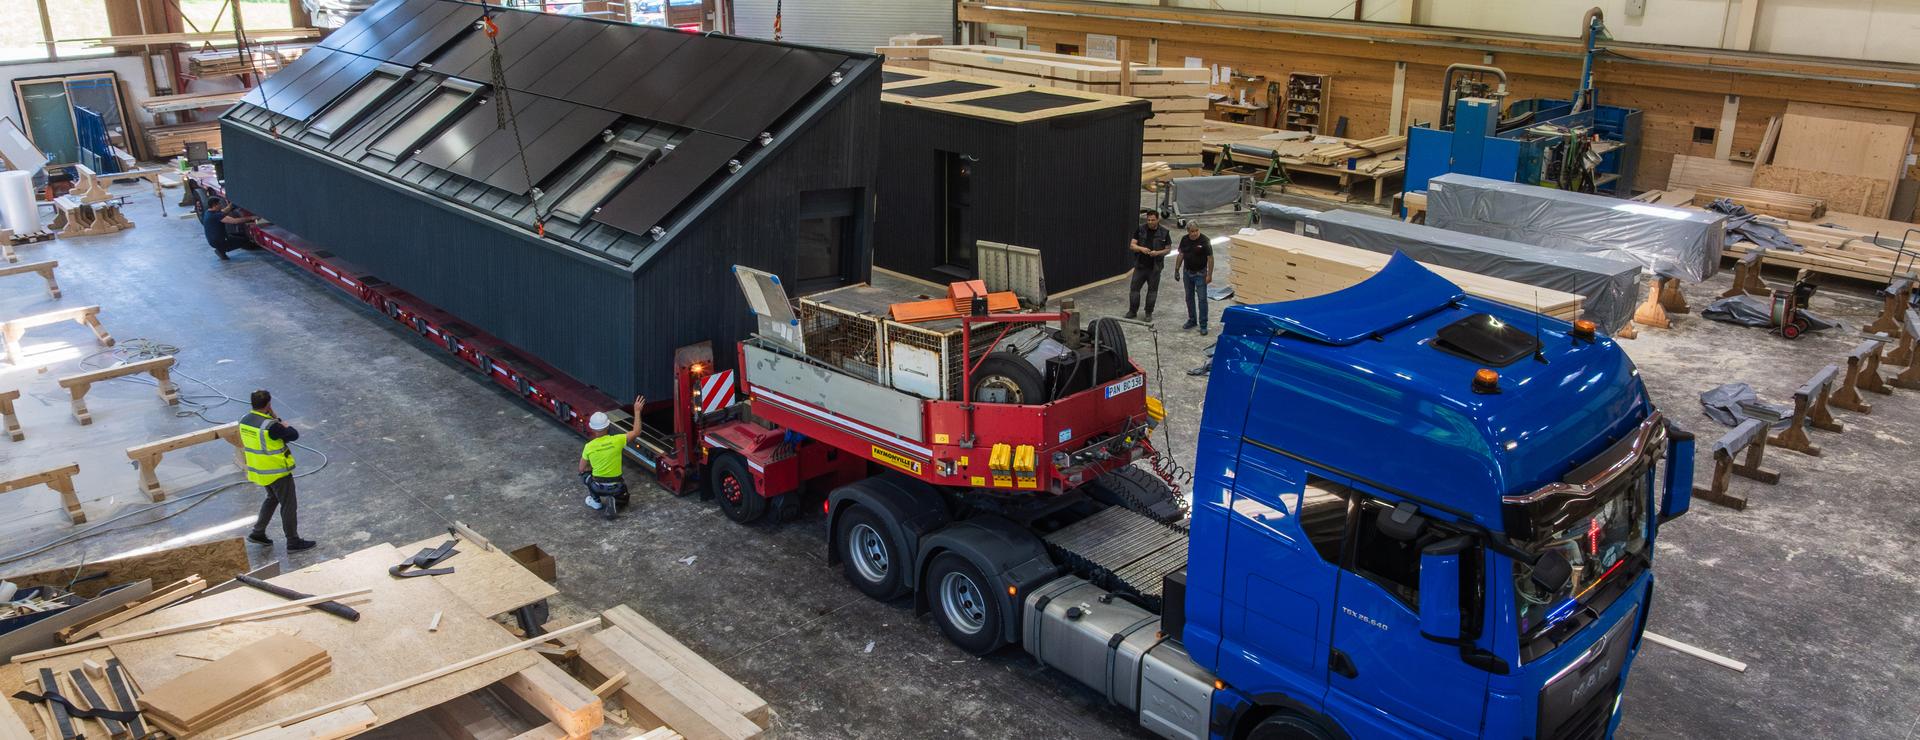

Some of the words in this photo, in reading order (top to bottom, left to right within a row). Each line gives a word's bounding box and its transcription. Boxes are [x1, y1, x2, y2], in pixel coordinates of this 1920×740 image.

[1109, 384, 1121, 396] PAN
[873, 448, 911, 466] FAYMONVILLE
[1569, 659, 1610, 704] MAN
